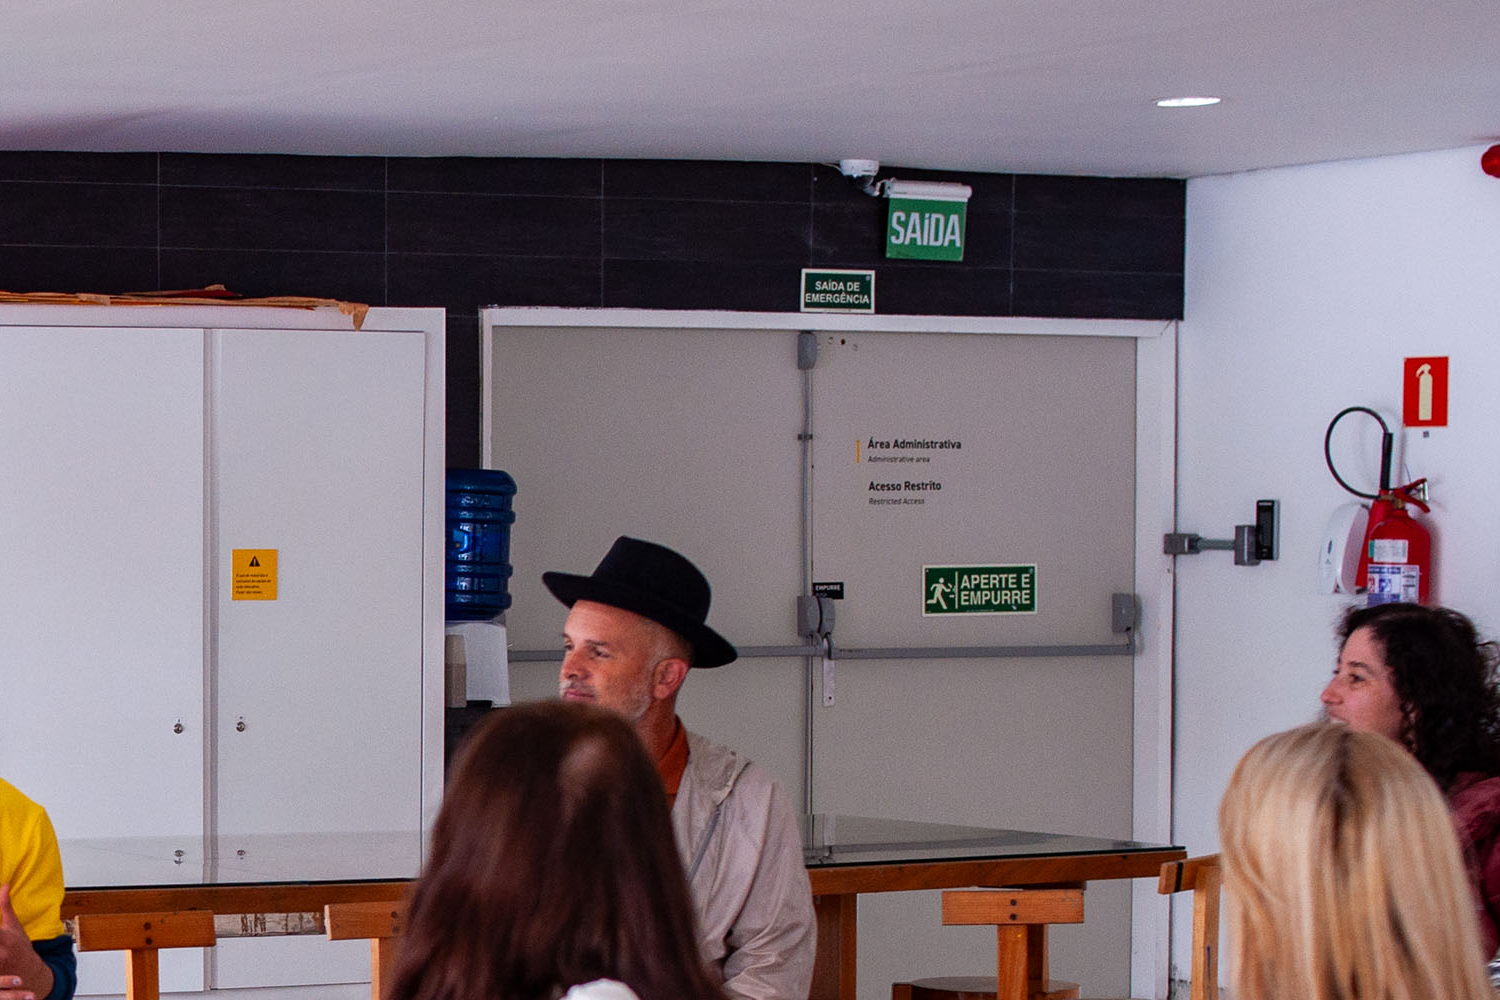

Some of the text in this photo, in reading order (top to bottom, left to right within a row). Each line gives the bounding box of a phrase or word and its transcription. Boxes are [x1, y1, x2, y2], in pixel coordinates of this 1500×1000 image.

[815, 279, 860, 292] SAÍDA DE
[805, 292, 870, 304] EMERGÊNCIA
[868, 436, 962, 449] Área Administrativa
[868, 455, 914, 463] Administrative
[868, 480, 942, 491] Acesso Restrito
[960, 573, 1031, 589] APERTE E
[960, 590, 1031, 605] EMPURRE
